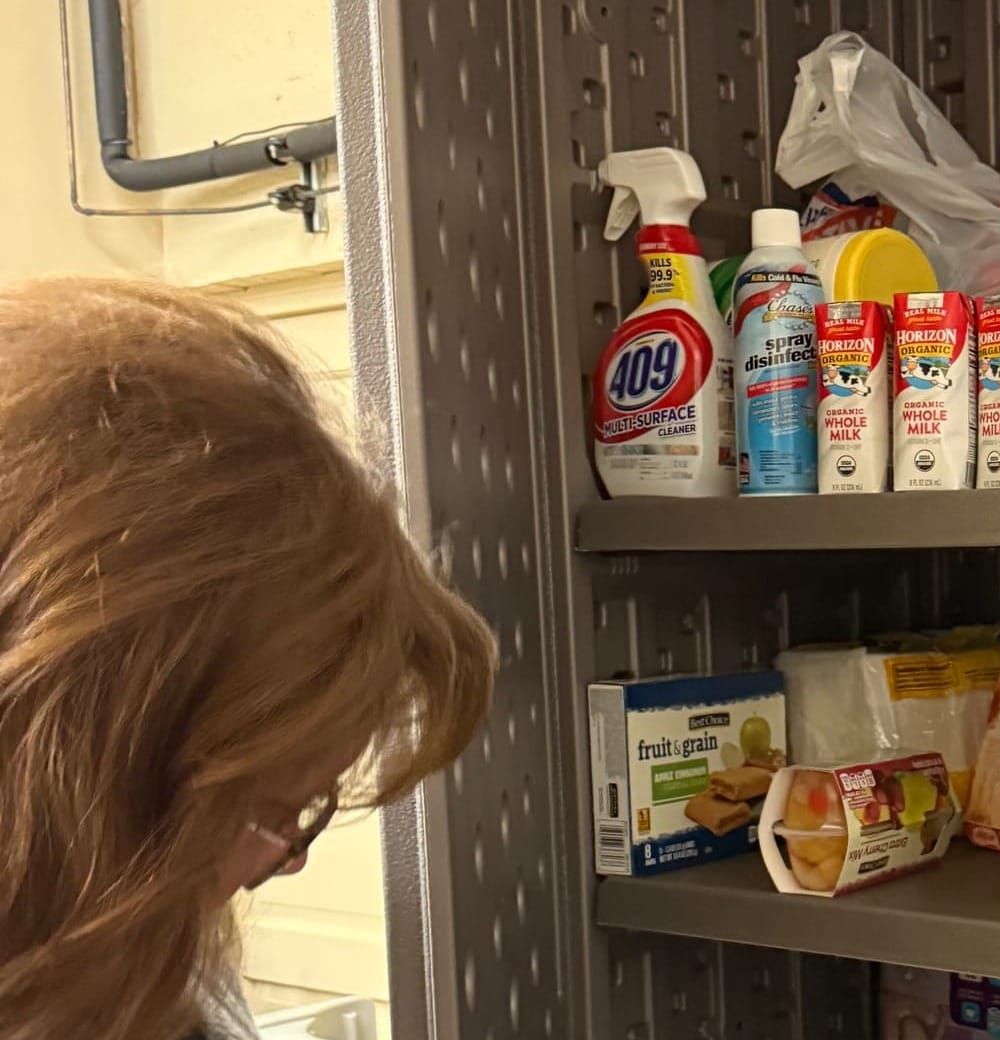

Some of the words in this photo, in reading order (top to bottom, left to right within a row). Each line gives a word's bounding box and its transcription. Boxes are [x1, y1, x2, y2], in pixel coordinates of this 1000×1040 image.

[650, 258, 672, 268] KILLS
[904, 309, 924, 318] REAL
[927, 308, 947, 316] MILK
[824, 319, 843, 328] REAL
[846, 319, 865, 327] MILK
[765, 333, 813, 352] spray
[896, 328, 957, 345] HORIZON
[818, 337, 875, 355] HORIZON
[900, 344, 951, 356] ORGANIC
[822, 353, 869, 365] ORGANIC
[608, 338, 678, 400] 409
[904, 401, 944, 409] ORGANIC
[826, 408, 864, 416] ORGANIC
[902, 410, 947, 422] WHOLE
[603, 405, 696, 438] MULTI-SURFACE
[825, 417, 867, 429] WHOLE
[658, 424, 696, 437] CLEANER
[830, 429, 861, 441] MILK
[907, 423, 941, 435] MILK
[638, 736, 672, 761] fruit
[673, 740, 681, 755] &
[682, 731, 718, 758] grain
[645, 845, 651, 859] 8
